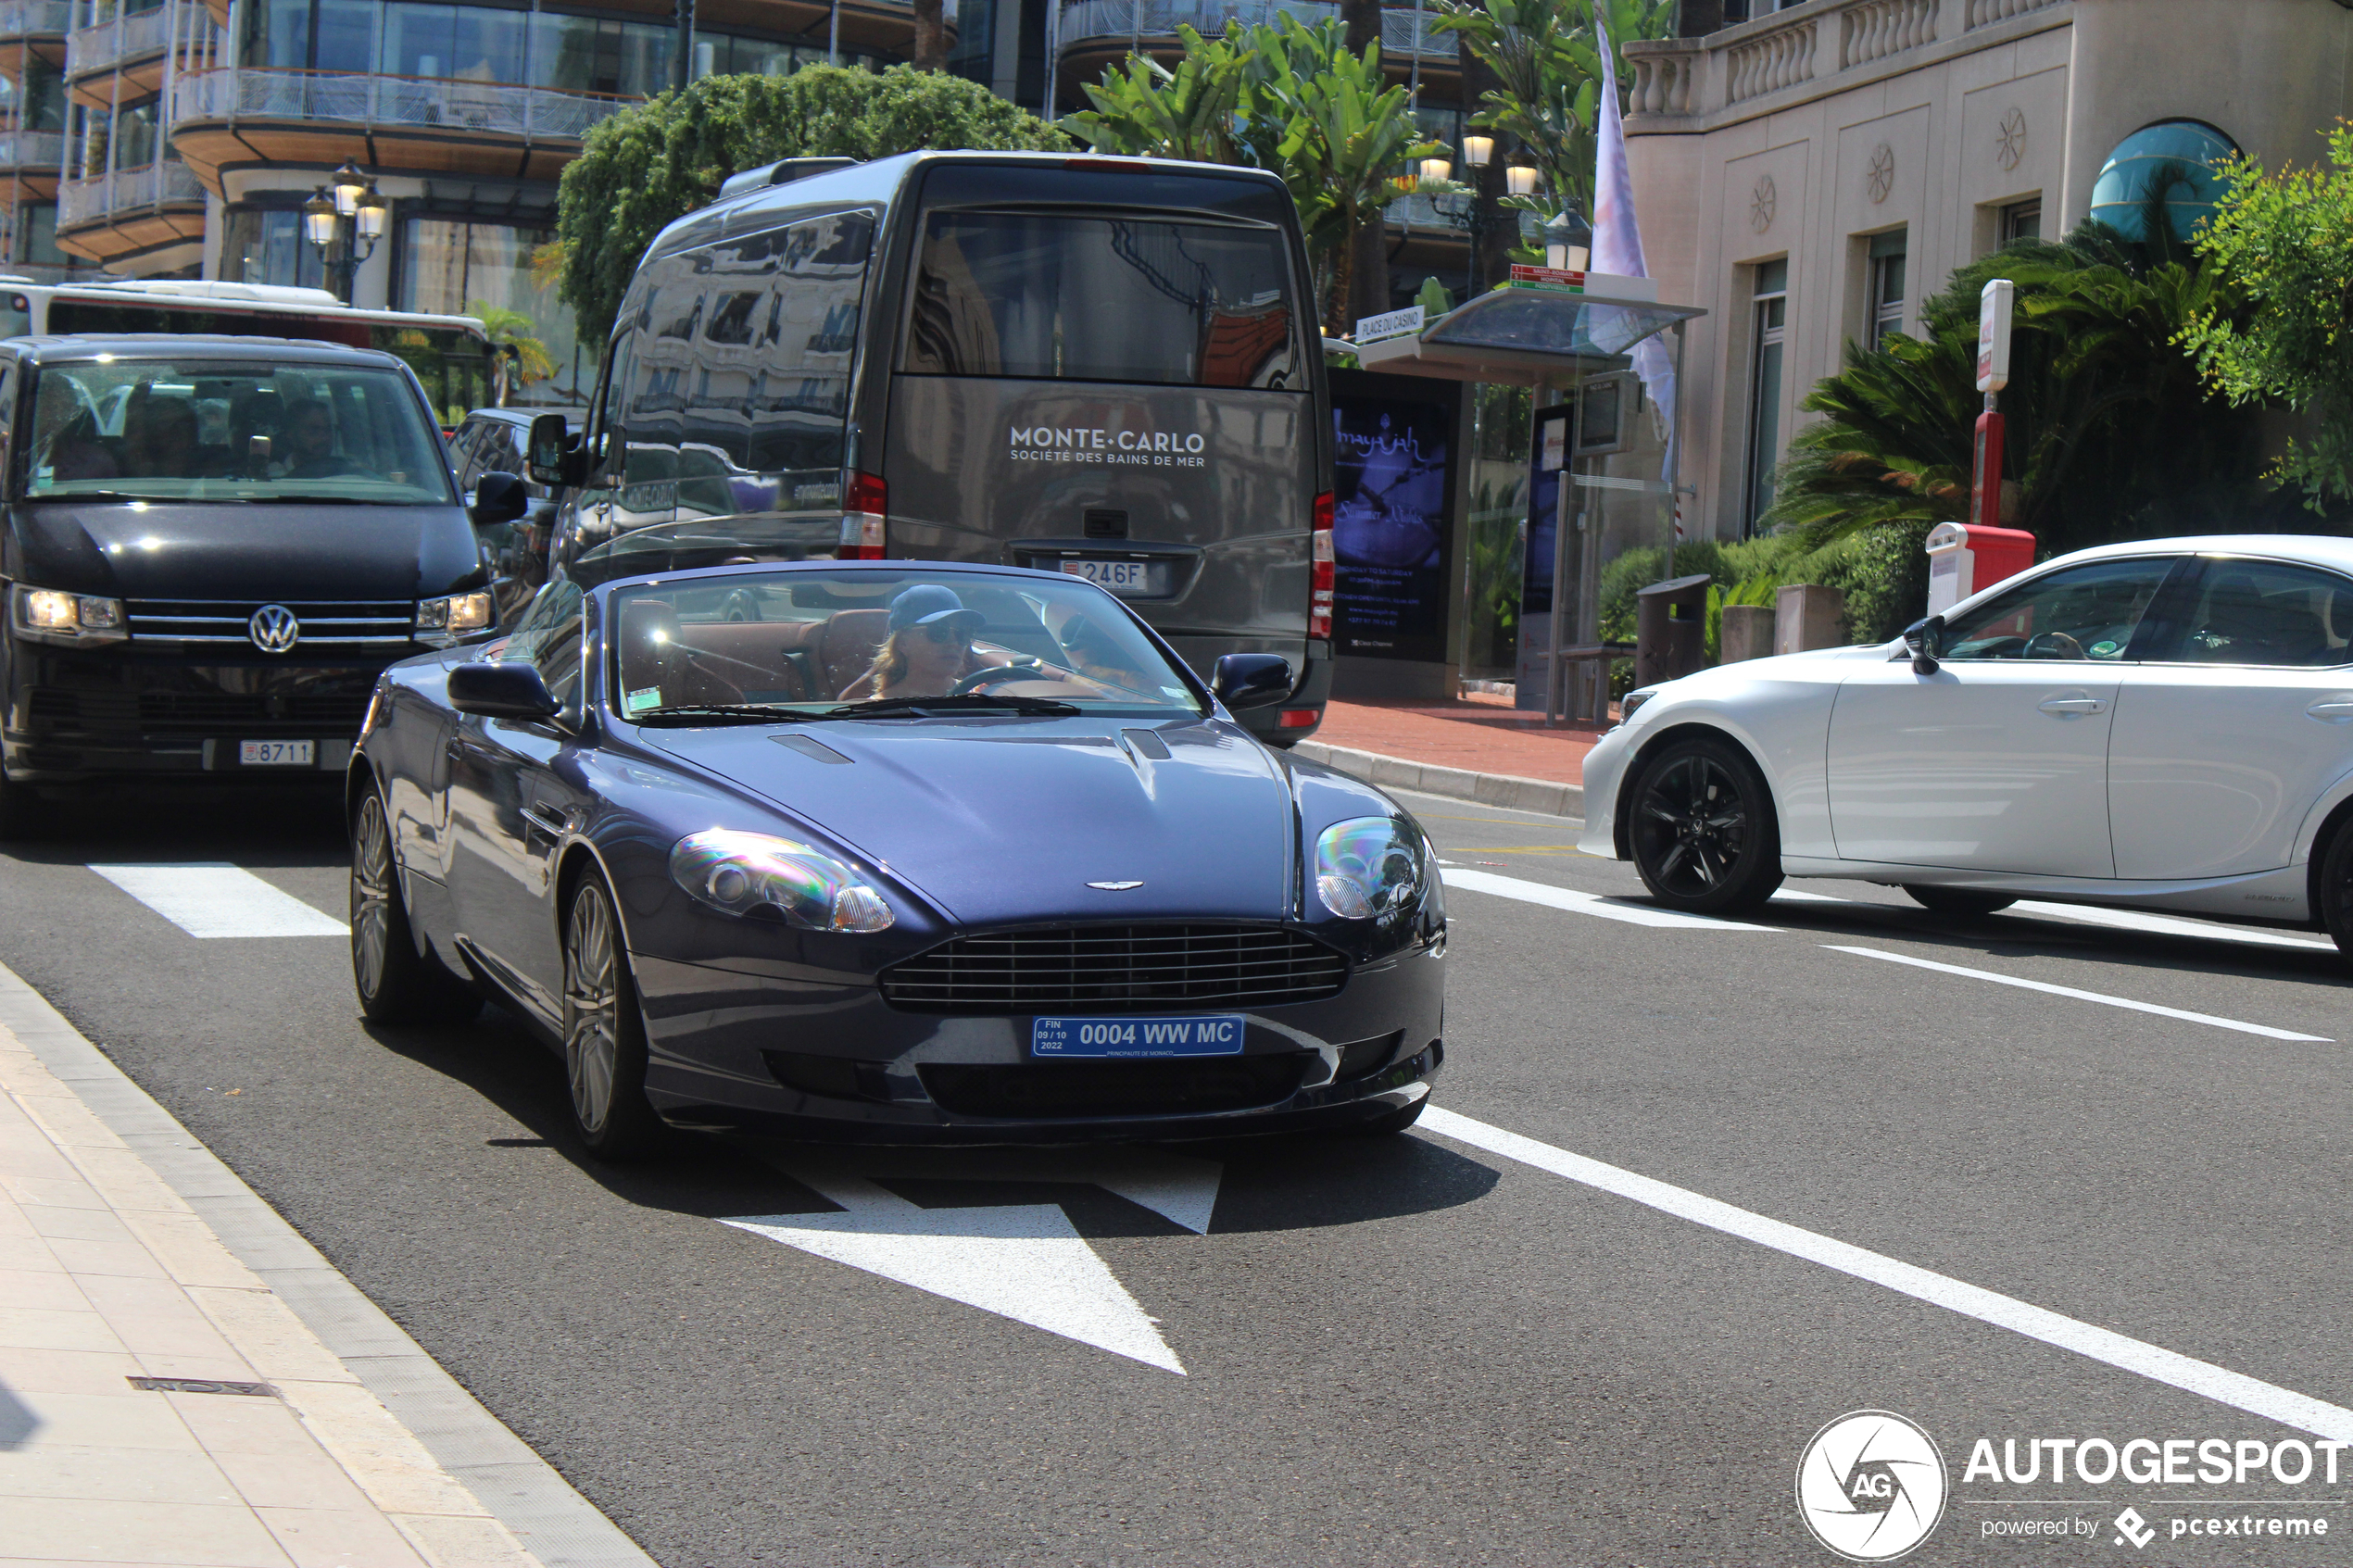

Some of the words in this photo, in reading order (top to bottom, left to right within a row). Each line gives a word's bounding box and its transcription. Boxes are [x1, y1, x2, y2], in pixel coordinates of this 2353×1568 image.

[1533, 268, 1574, 277] SAINT-ROMAN
[1362, 320, 1382, 336] PLACE
[1383, 317, 1392, 332] DU
[1393, 311, 1418, 329] CASINO
[1011, 449, 1070, 462] SOCIÉTÉ
[1076, 452, 1102, 463] DES
[1107, 453, 1149, 465] BAINS
[1154, 456, 1172, 466] DE
[1176, 457, 1205, 467] MER
[1336, 500, 1382, 521] Summer
[1085, 562, 1140, 584] 246F
[1378, 568, 1413, 576] SATURDAY
[260, 744, 308, 761] 8711
[1045, 1020, 1061, 1029] FIN
[1079, 1024, 1136, 1044] 0004
[1143, 1023, 1190, 1044] WW
[1197, 1022, 1234, 1042] MC
[1038, 1031, 1048, 1039] 09
[1056, 1031, 1066, 1039] 10
[1040, 1041, 1063, 1050] 2022
